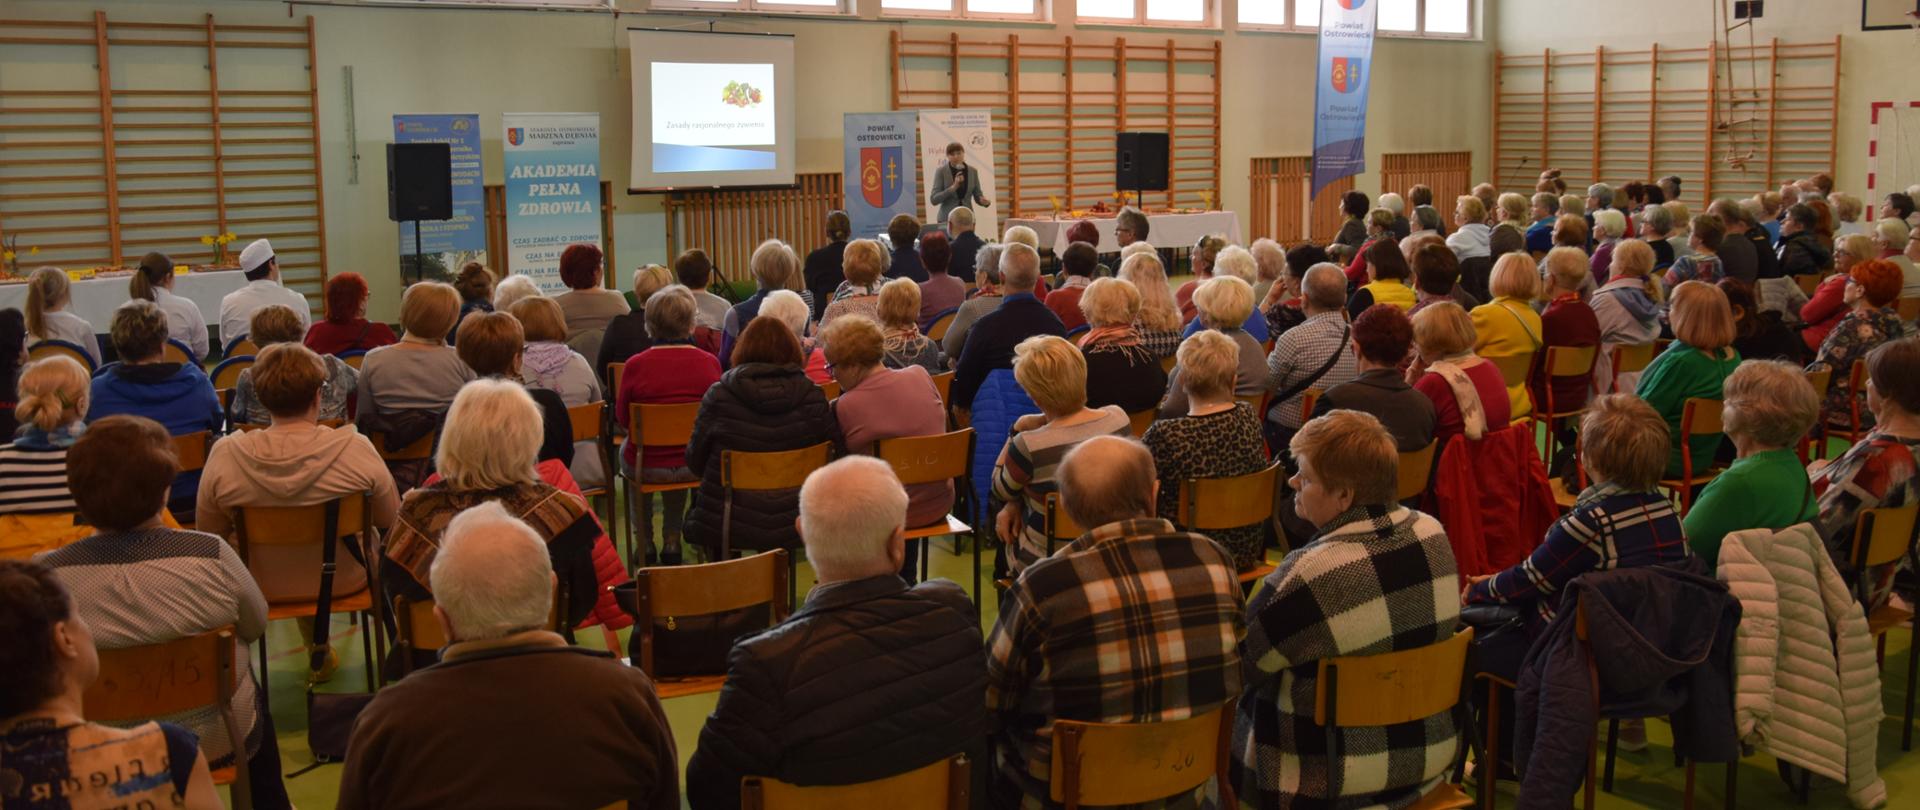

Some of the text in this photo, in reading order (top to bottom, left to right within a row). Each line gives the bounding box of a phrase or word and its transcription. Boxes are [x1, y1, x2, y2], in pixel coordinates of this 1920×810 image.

[1334, 21, 1364, 30] Powiat
[1330, 104, 1359, 113] Powiat
[666, 120, 690, 130] Zasady
[867, 124, 895, 132] POWIAT
[529, 132, 564, 140] MARZENA
[856, 133, 906, 142] OSTROWIECKI
[510, 163, 597, 179] AKADEMIA
[528, 182, 581, 197] PEŁNA
[518, 200, 593, 216] ZDROWIA
